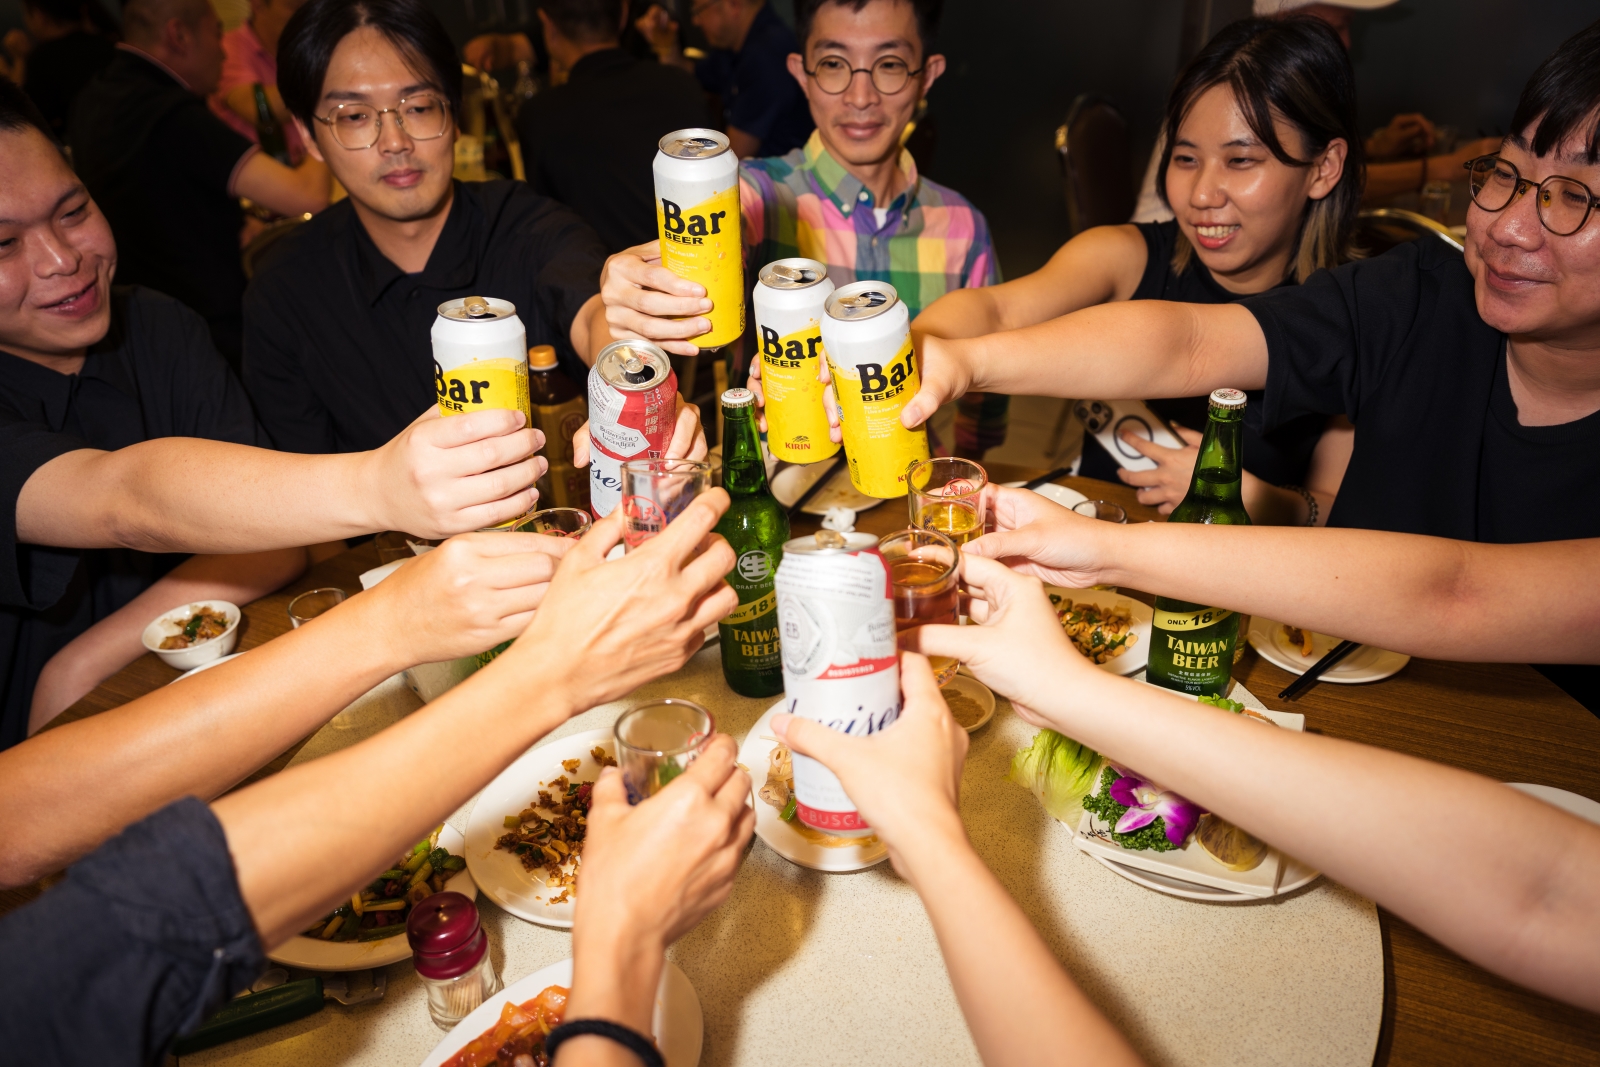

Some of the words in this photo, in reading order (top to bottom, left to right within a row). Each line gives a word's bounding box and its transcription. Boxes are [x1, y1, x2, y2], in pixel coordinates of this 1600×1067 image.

[661, 197, 726, 236] Bar
[664, 230, 704, 245] BEER
[761, 324, 823, 360] Bar
[764, 354, 801, 369] BEER
[856, 348, 914, 395] Bar
[434, 360, 490, 404] Bar
[862, 384, 904, 402] BEER
[785, 442, 811, 450] KIRIN
[739, 554, 771, 579] 生
[729, 611, 747, 619] ONLY
[749, 600, 769, 616] 18
[1191, 611, 1213, 626] 18
[1216, 609, 1227, 617] DA
[732, 626, 780, 644] TAIWA
[741, 643, 781, 657] BEER
[1166, 634, 1228, 655] TAIWAN
[1172, 652, 1219, 670] BEER
